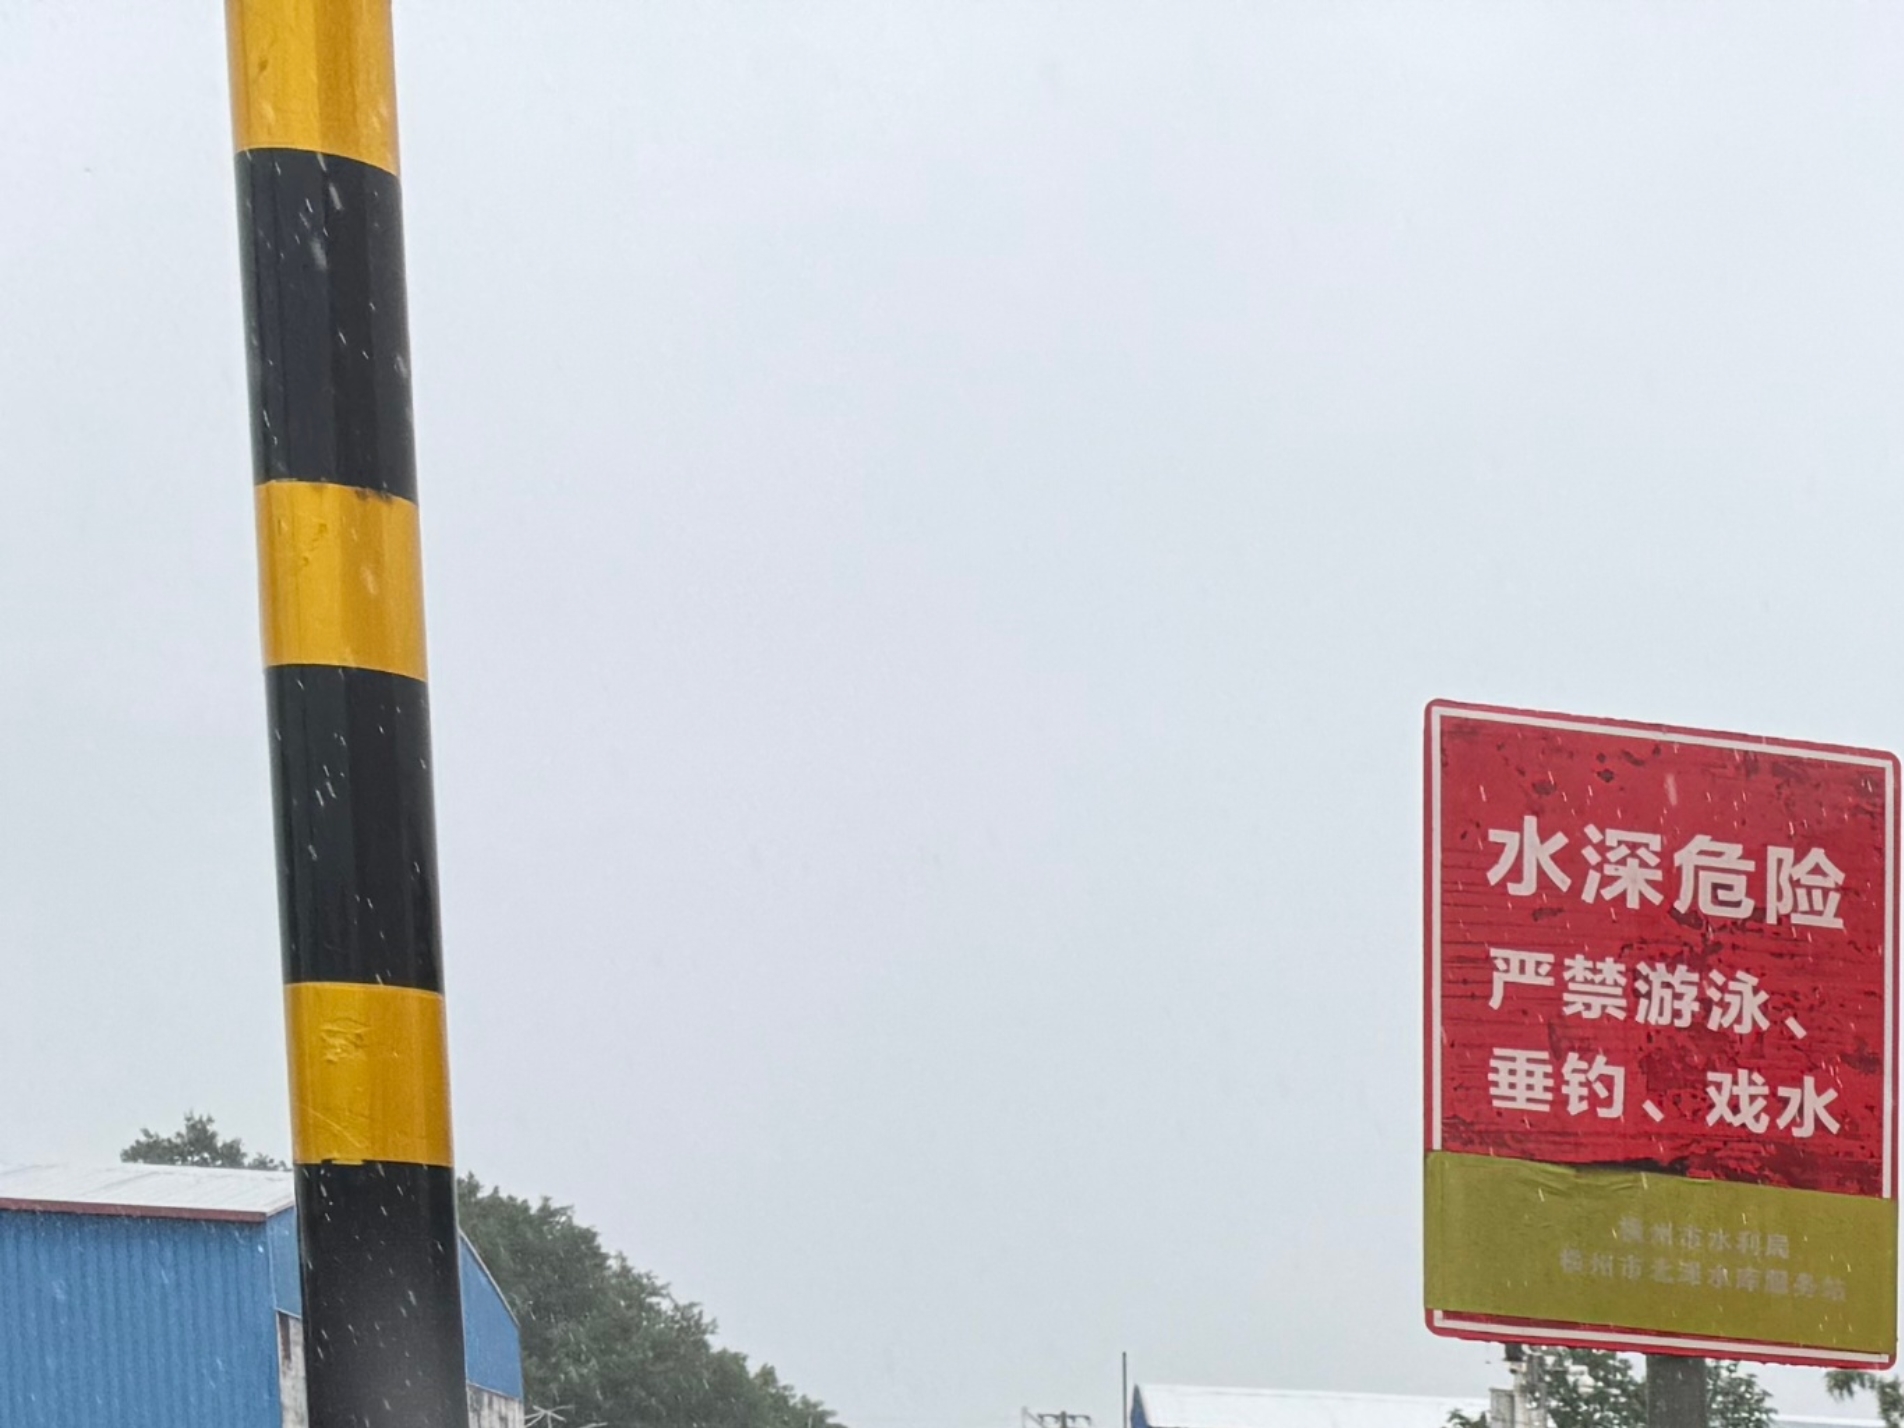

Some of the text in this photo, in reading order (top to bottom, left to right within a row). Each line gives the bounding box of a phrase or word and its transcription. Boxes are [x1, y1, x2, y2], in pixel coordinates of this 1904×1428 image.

[1486, 816, 1846, 930] 水深危险
[1488, 947, 1808, 1040] 严禁游泳、
[1487, 1047, 1841, 1138] 垂钓、戏水
